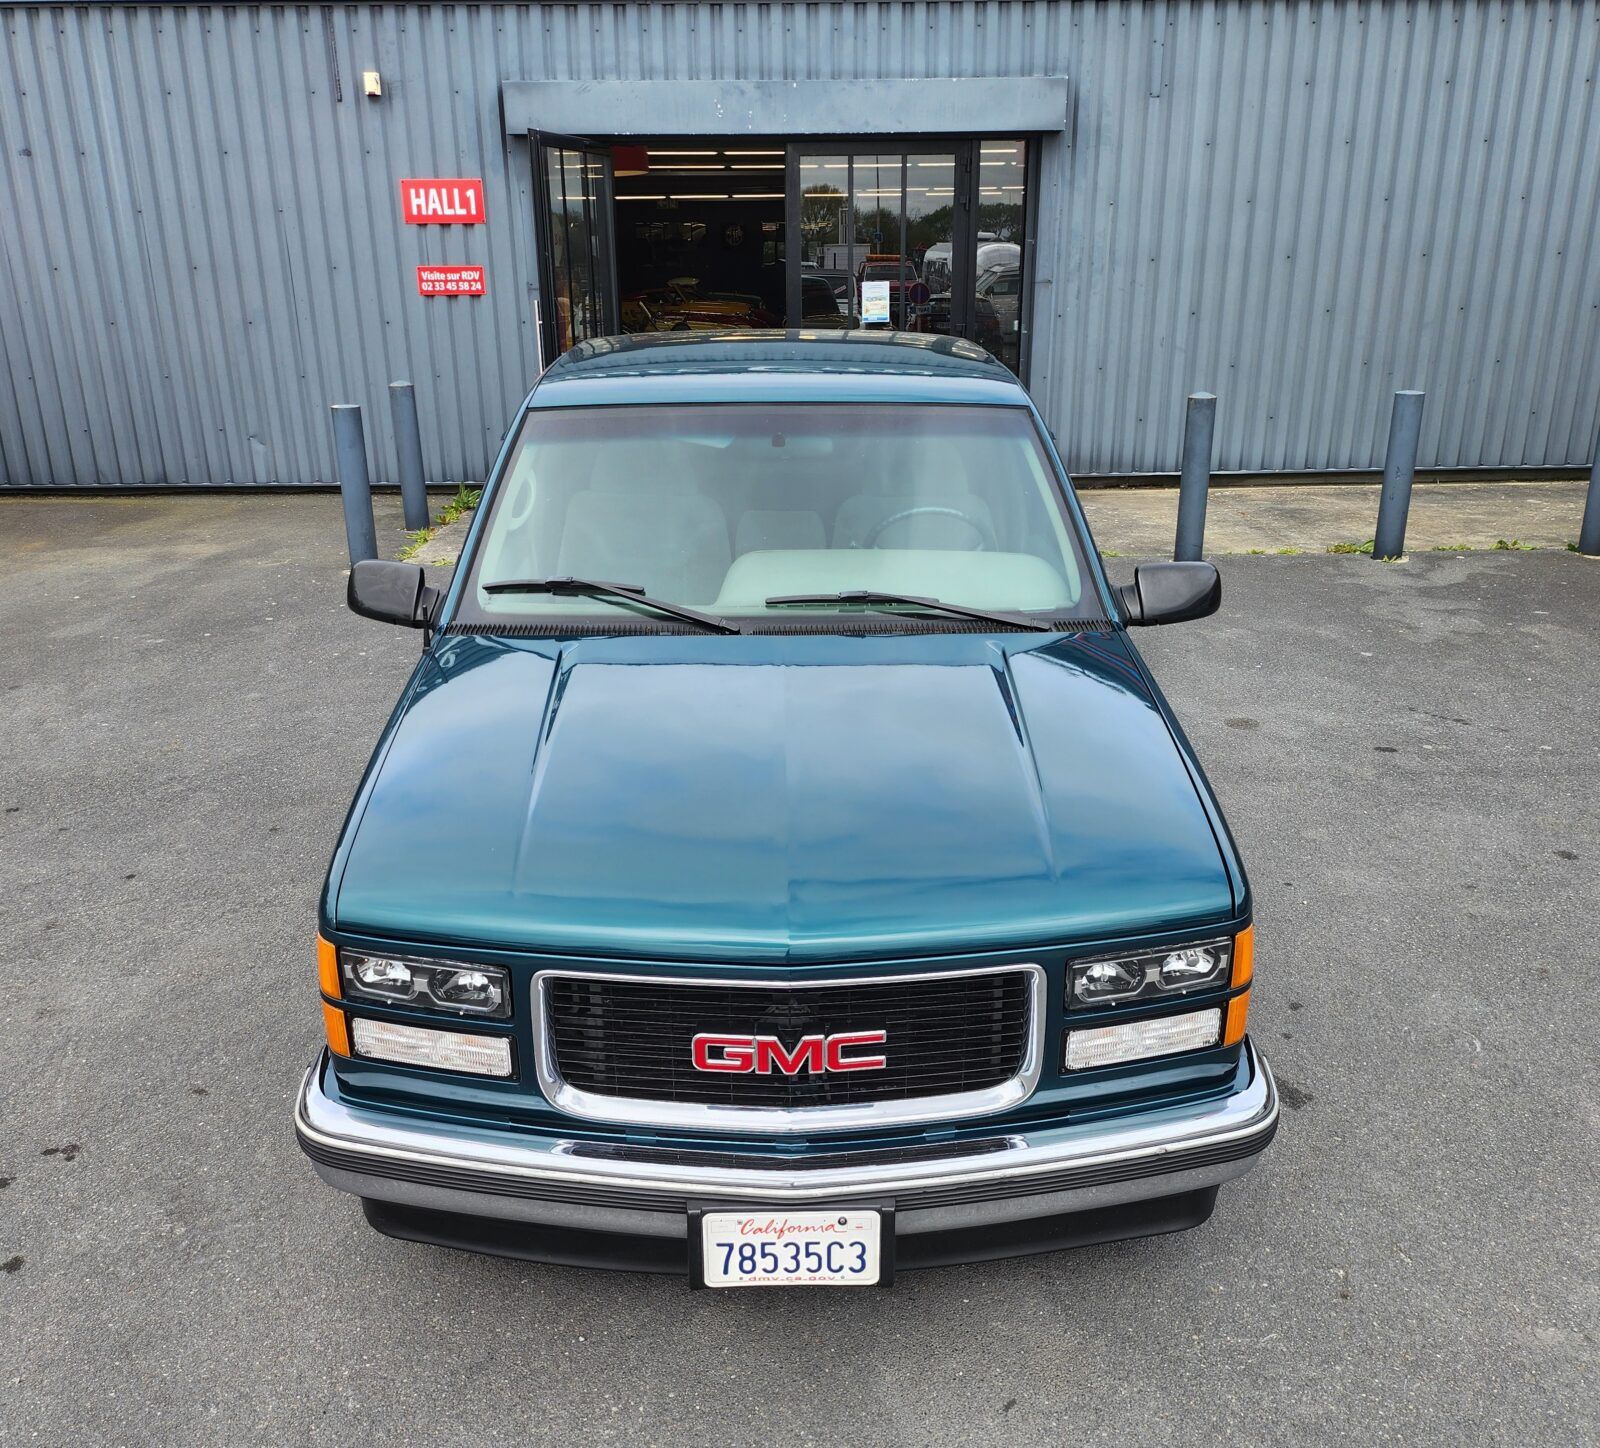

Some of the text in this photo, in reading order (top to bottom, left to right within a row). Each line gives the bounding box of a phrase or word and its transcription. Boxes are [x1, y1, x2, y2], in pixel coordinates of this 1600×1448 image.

[421, 270, 480, 281] Visite sur RDV
[422, 281, 482, 291] 02 33 45 58 24
[691, 1029, 887, 1075] GMC
[740, 1217, 847, 1240] California
[715, 1240, 867, 1276] 78535C3
